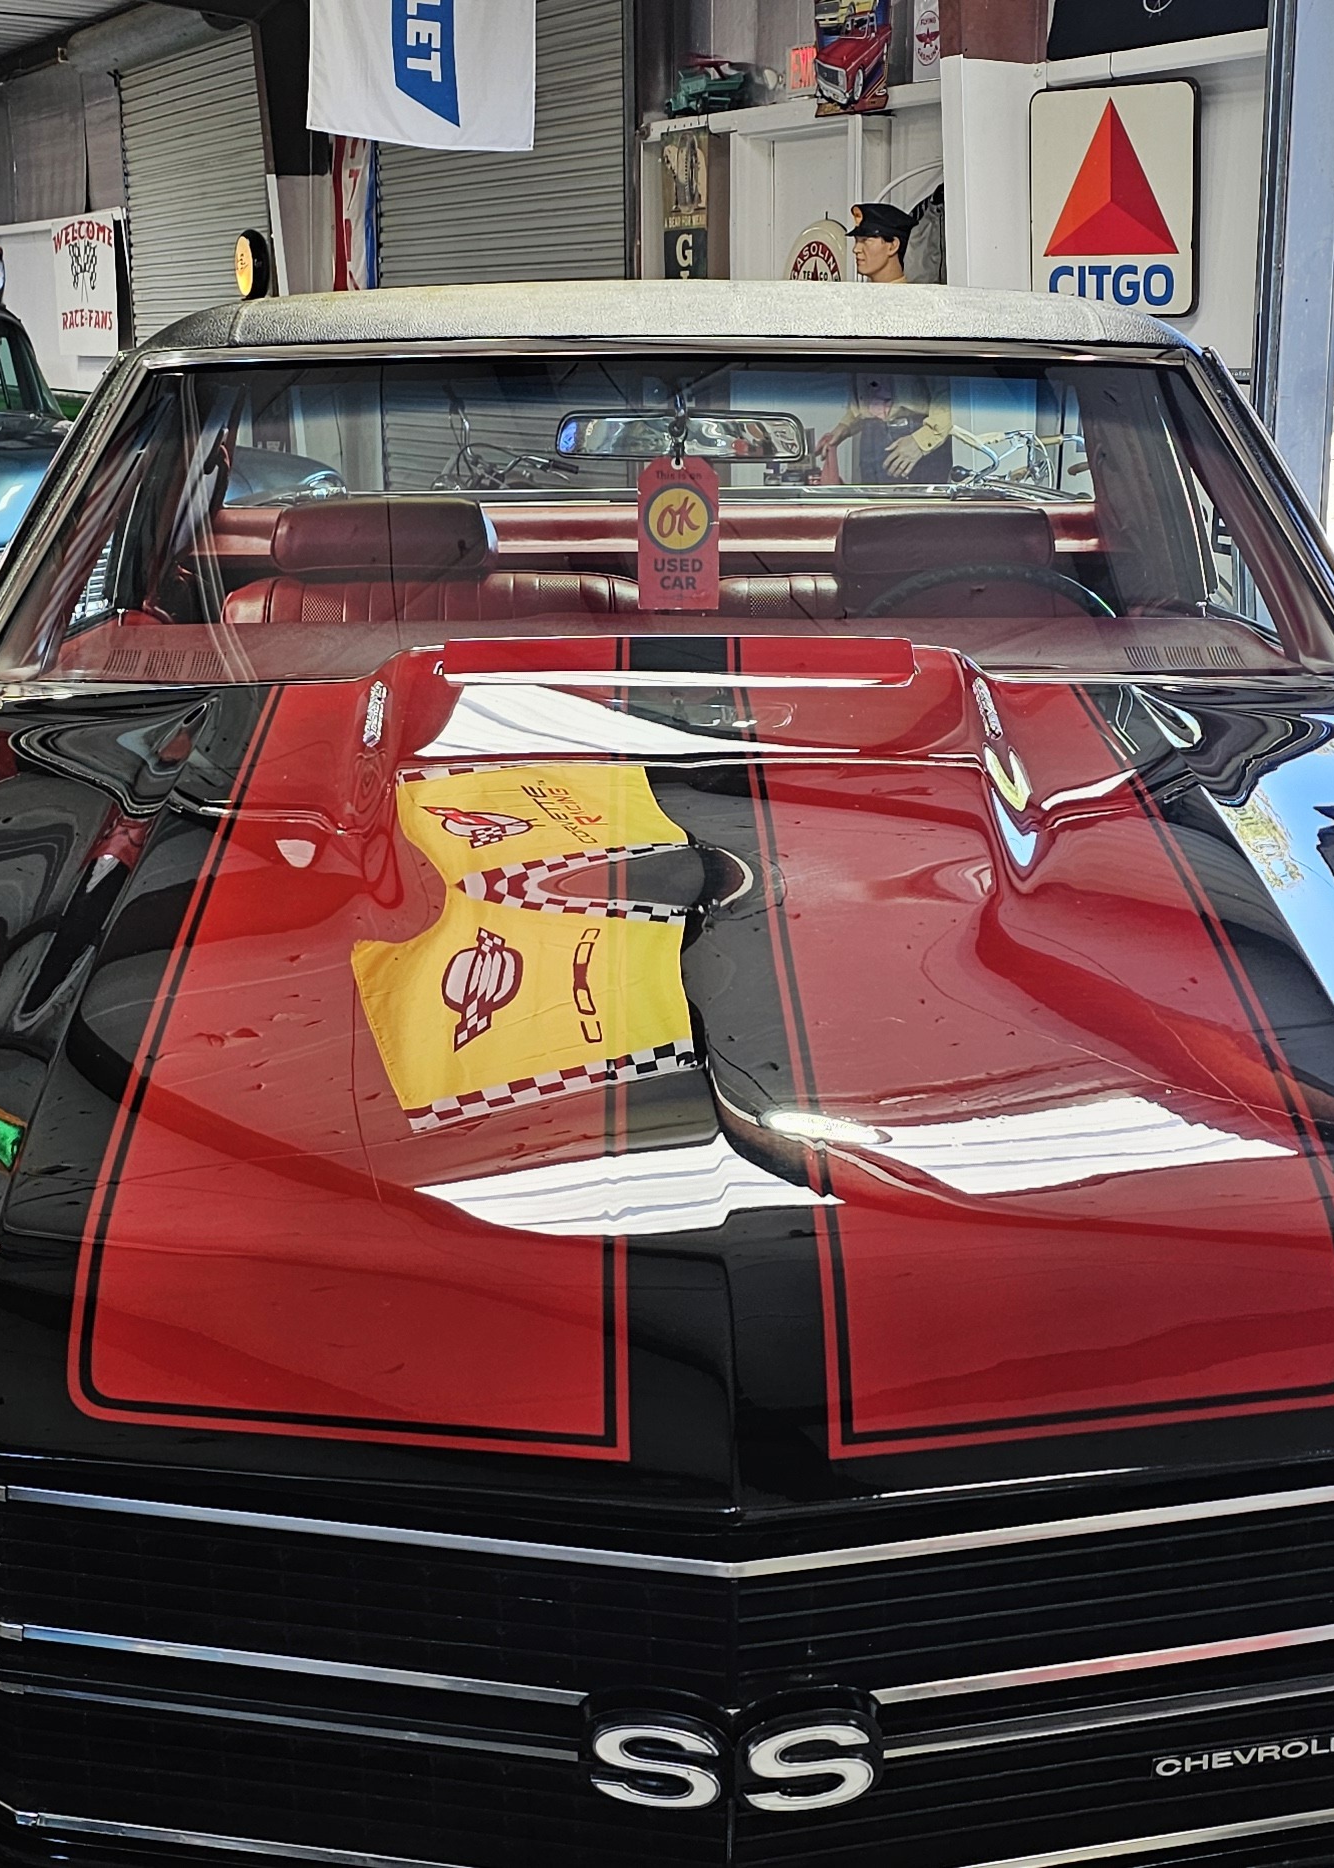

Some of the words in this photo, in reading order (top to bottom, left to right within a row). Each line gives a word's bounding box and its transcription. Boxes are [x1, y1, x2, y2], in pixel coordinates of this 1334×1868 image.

[53, 220, 113, 254] WELCOME
[1049, 264, 1175, 306] CITGO
[656, 496, 700, 539] OK
[653, 558, 703, 573] USED
[660, 576, 697, 590] CAR
[590, 1724, 874, 1812] SS
